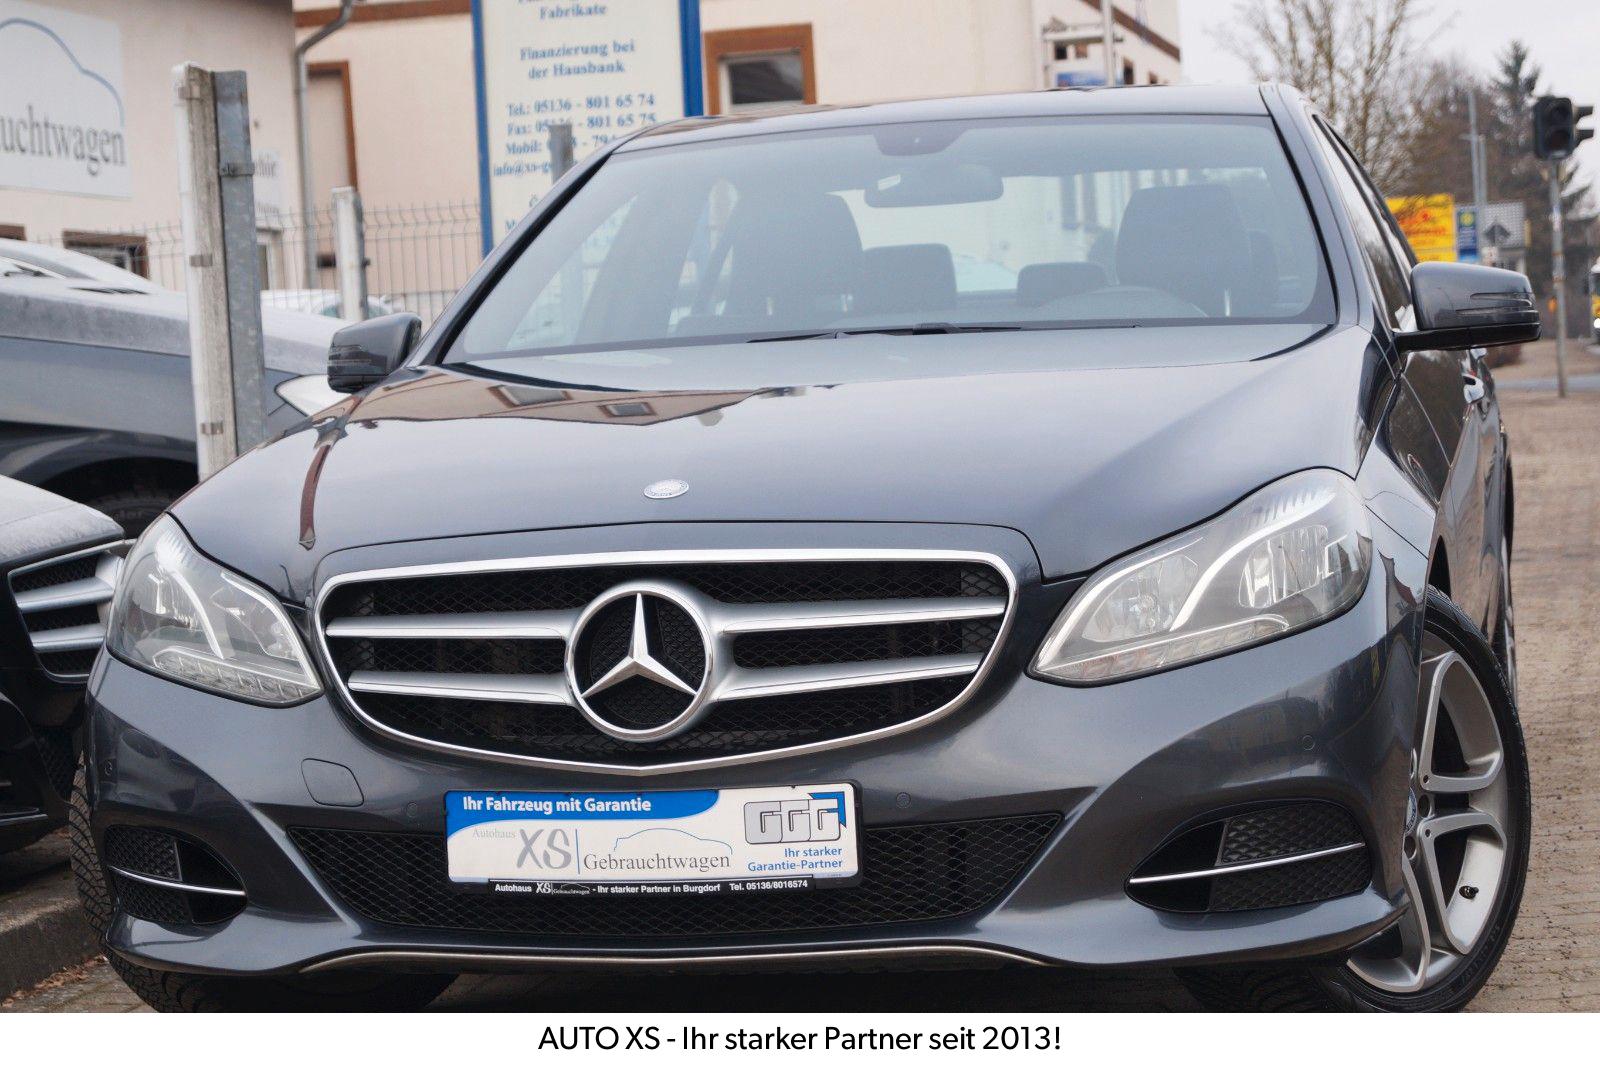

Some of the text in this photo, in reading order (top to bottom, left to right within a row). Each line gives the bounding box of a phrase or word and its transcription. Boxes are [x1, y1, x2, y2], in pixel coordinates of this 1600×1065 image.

[540, 6, 607, 19] Fabrikate
[520, 39, 635, 61] Finanzierung bei
[528, 60, 625, 80] der Hausbank
[534, 98, 572, 113] 05136
[586, 95, 610, 109] 801
[616, 94, 633, 108] 65
[638, 92, 655, 106] 74
[507, 123, 531, 136] Fax:
[587, 115, 611, 128] 801
[617, 114, 634, 127] 65
[506, 139, 542, 155] Mobil:
[463, 796, 652, 815] Ihr Fahrzeug mit Garantie
[472, 828, 517, 839] Autohaus
[516, 828, 572, 870] XS
[784, 846, 843, 858] Ihr starker
[583, 852, 730, 873] Gebrauchtwagen
[747, 860, 843, 872] Garantie-Partner
[494, 883, 532, 893] Autohaus
[535, 882, 551, 894] XS
[597, 885, 608, 893] Ihr
[610, 885, 639, 893] starker
[641, 885, 672, 893] Partner
[673, 884, 681, 893] in
[683, 884, 721, 894] Burgdorf
[729, 883, 745, 891] Tel.
